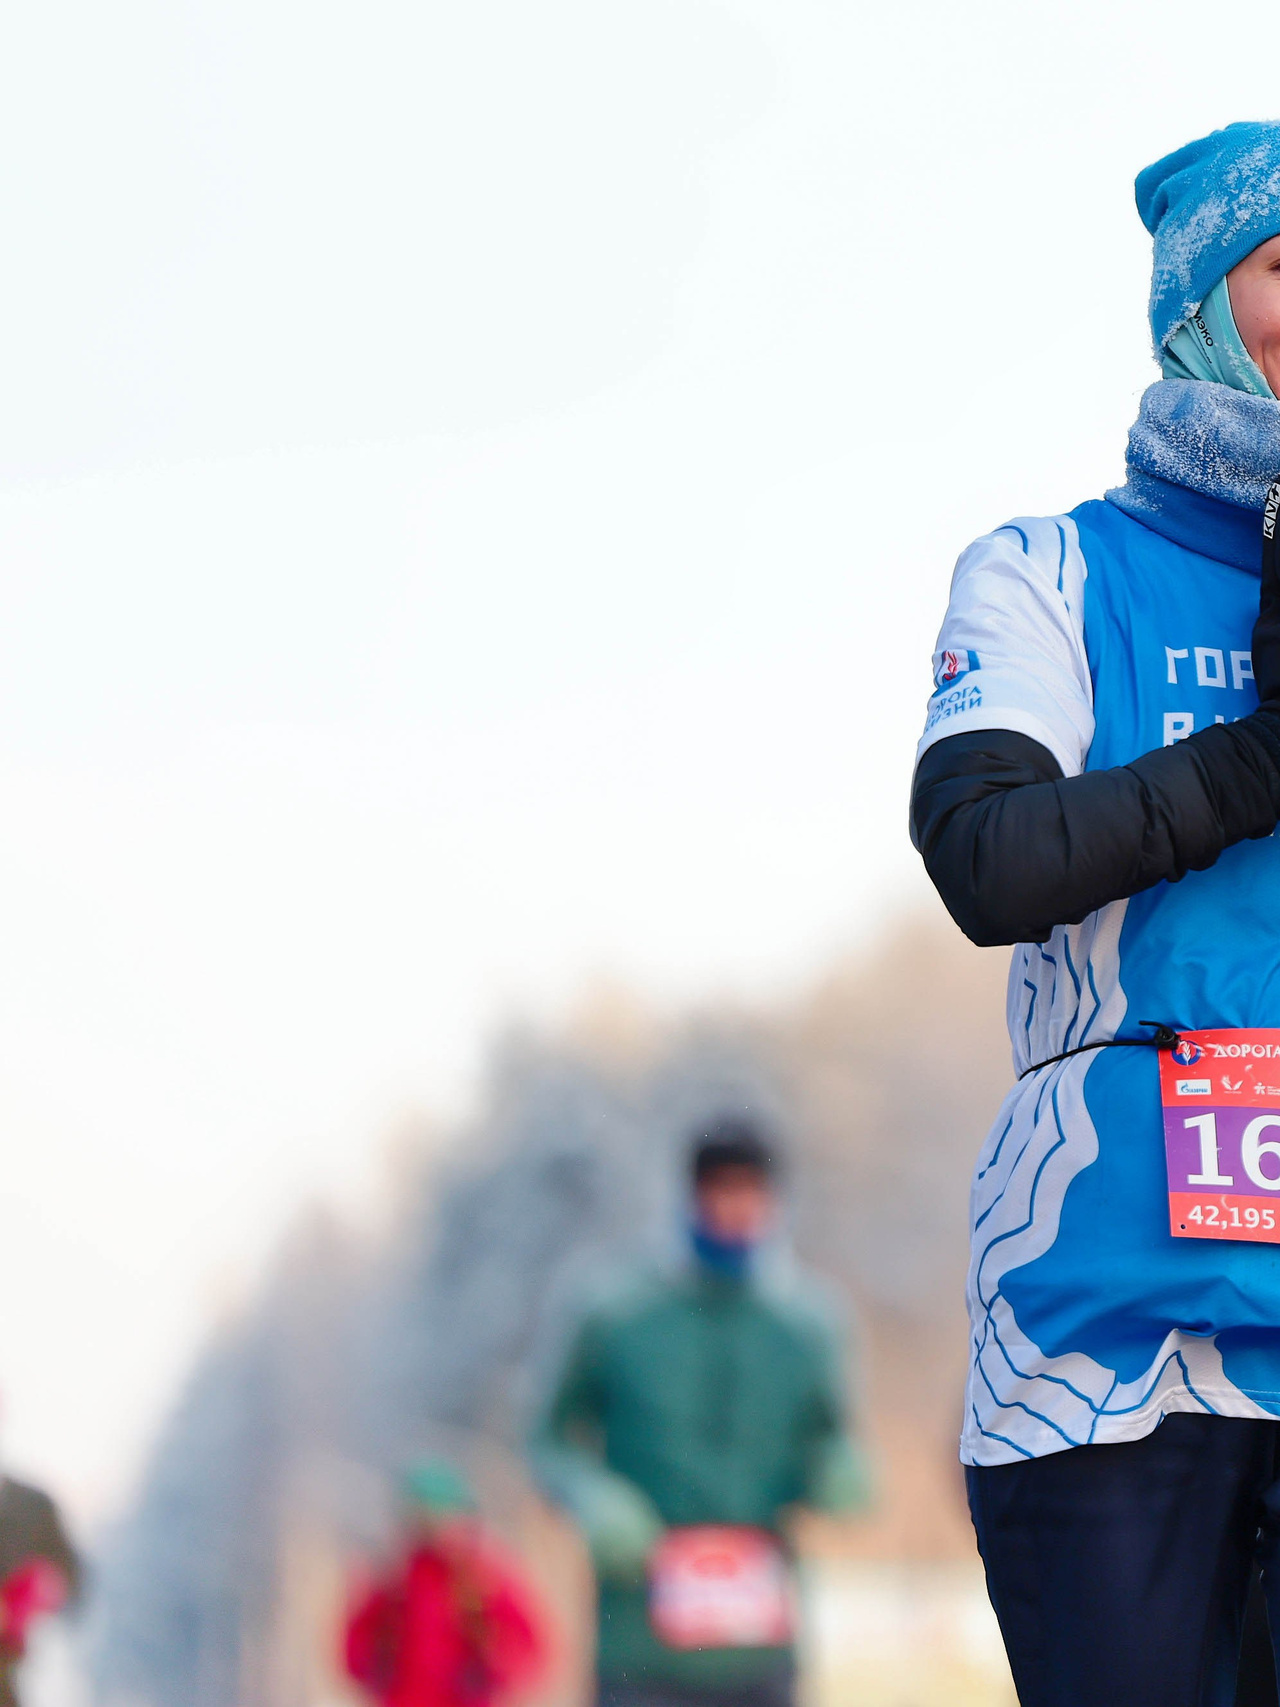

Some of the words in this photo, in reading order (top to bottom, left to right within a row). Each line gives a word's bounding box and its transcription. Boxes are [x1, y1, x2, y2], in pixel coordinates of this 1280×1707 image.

[1164, 646, 1255, 690] ГОР
[925, 697, 982, 733] ИЗНИ
[929, 686, 982, 722] ОРОГА
[1188, 1205, 1276, 1229] 42,195
